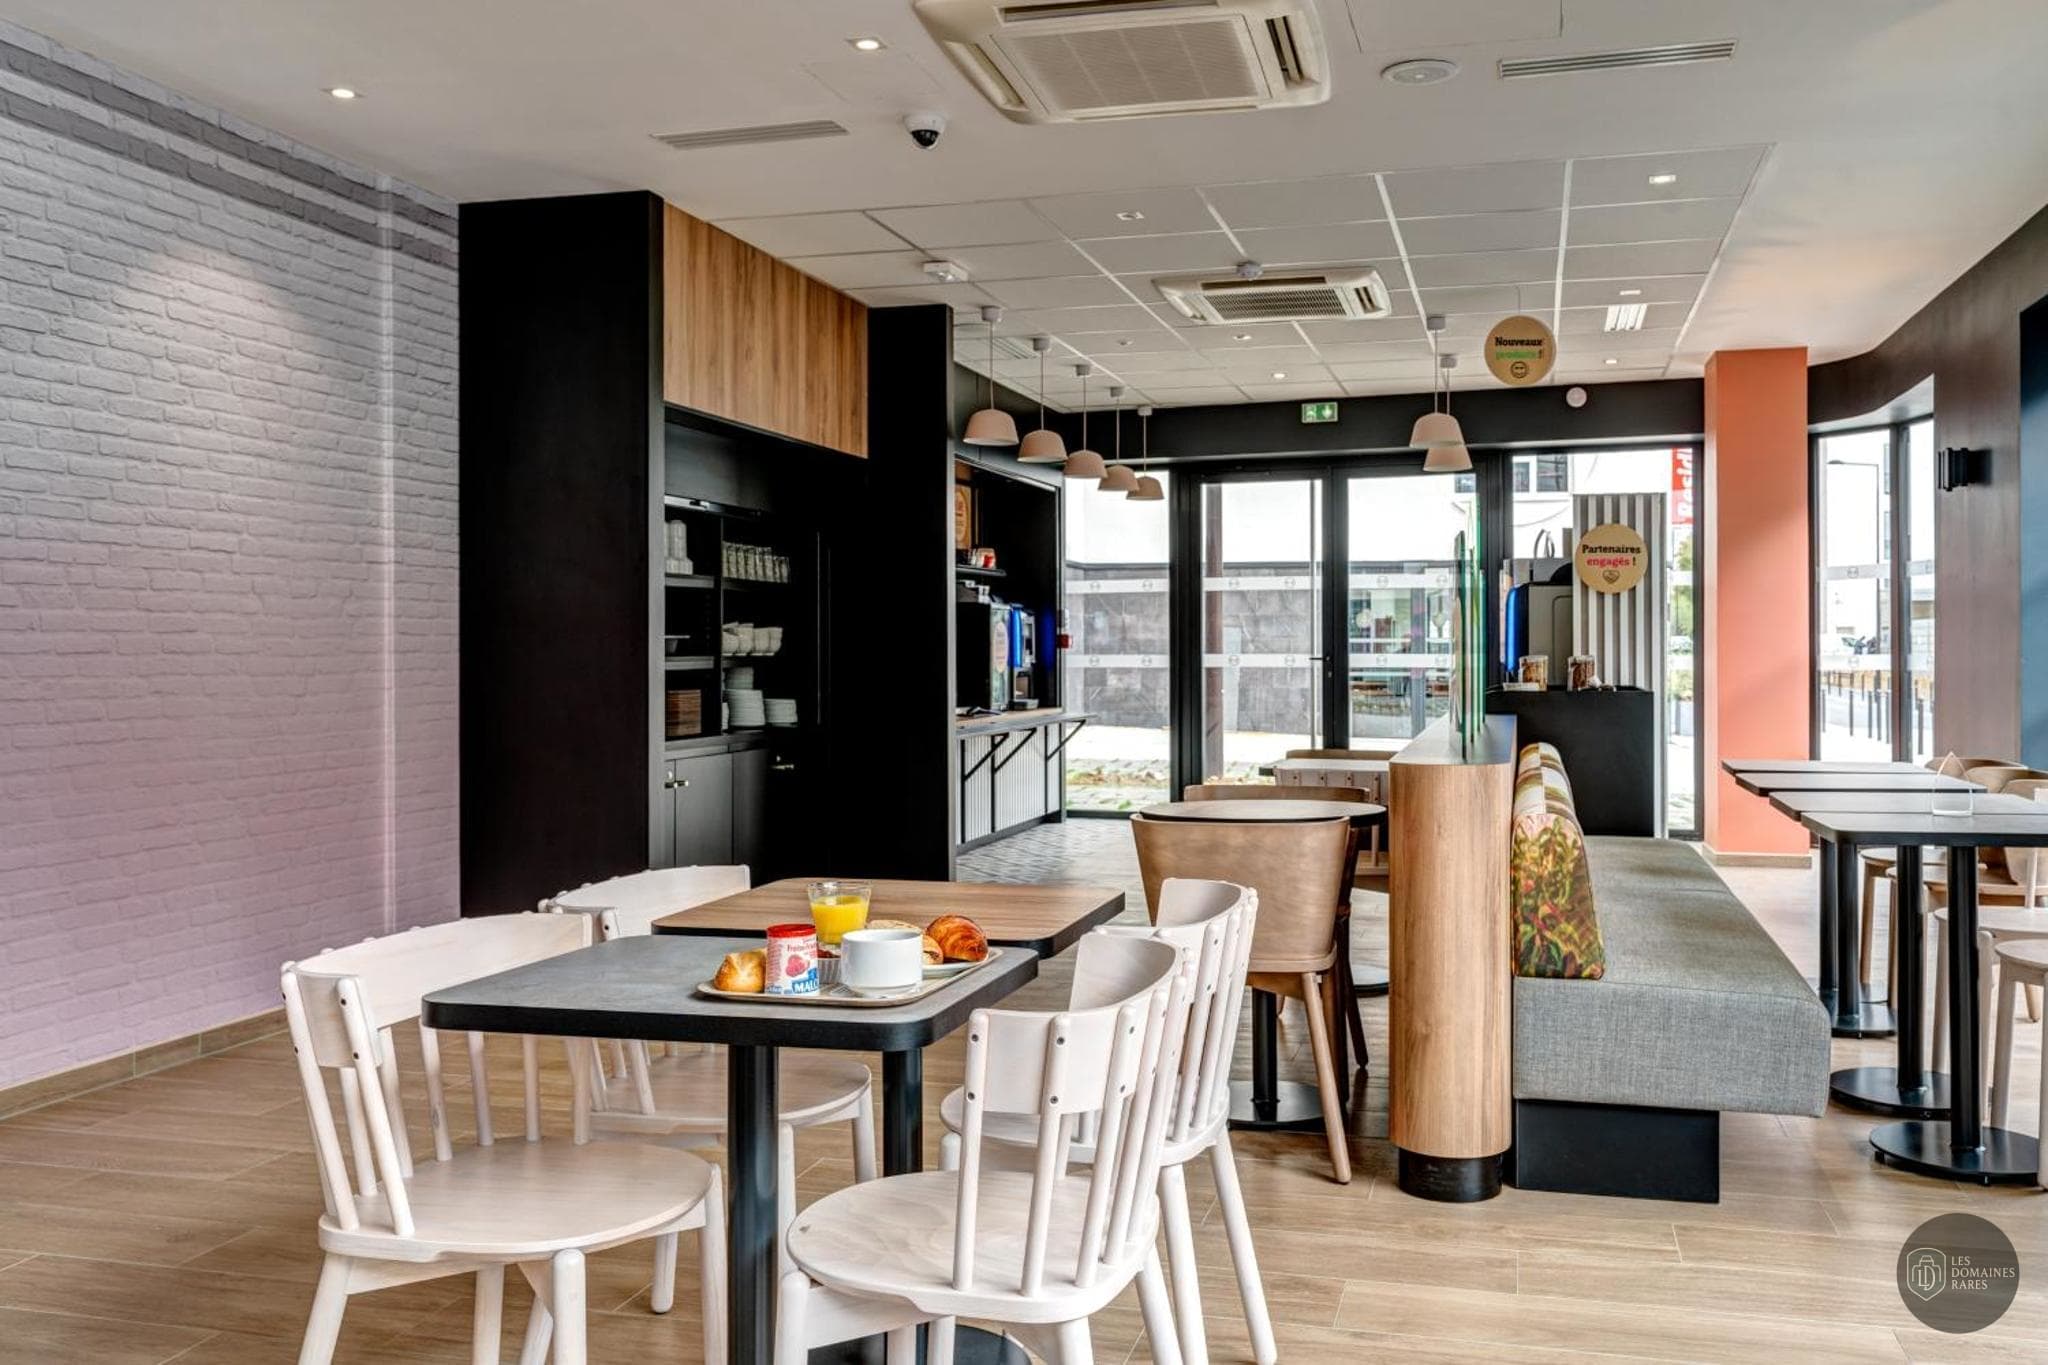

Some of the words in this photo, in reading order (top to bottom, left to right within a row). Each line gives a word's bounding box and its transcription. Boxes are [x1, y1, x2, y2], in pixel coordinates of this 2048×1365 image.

[1495, 336, 1543, 346] Nouveaux
[1582, 544, 1641, 554] Partenaires
[1586, 556, 1630, 569] engagés
